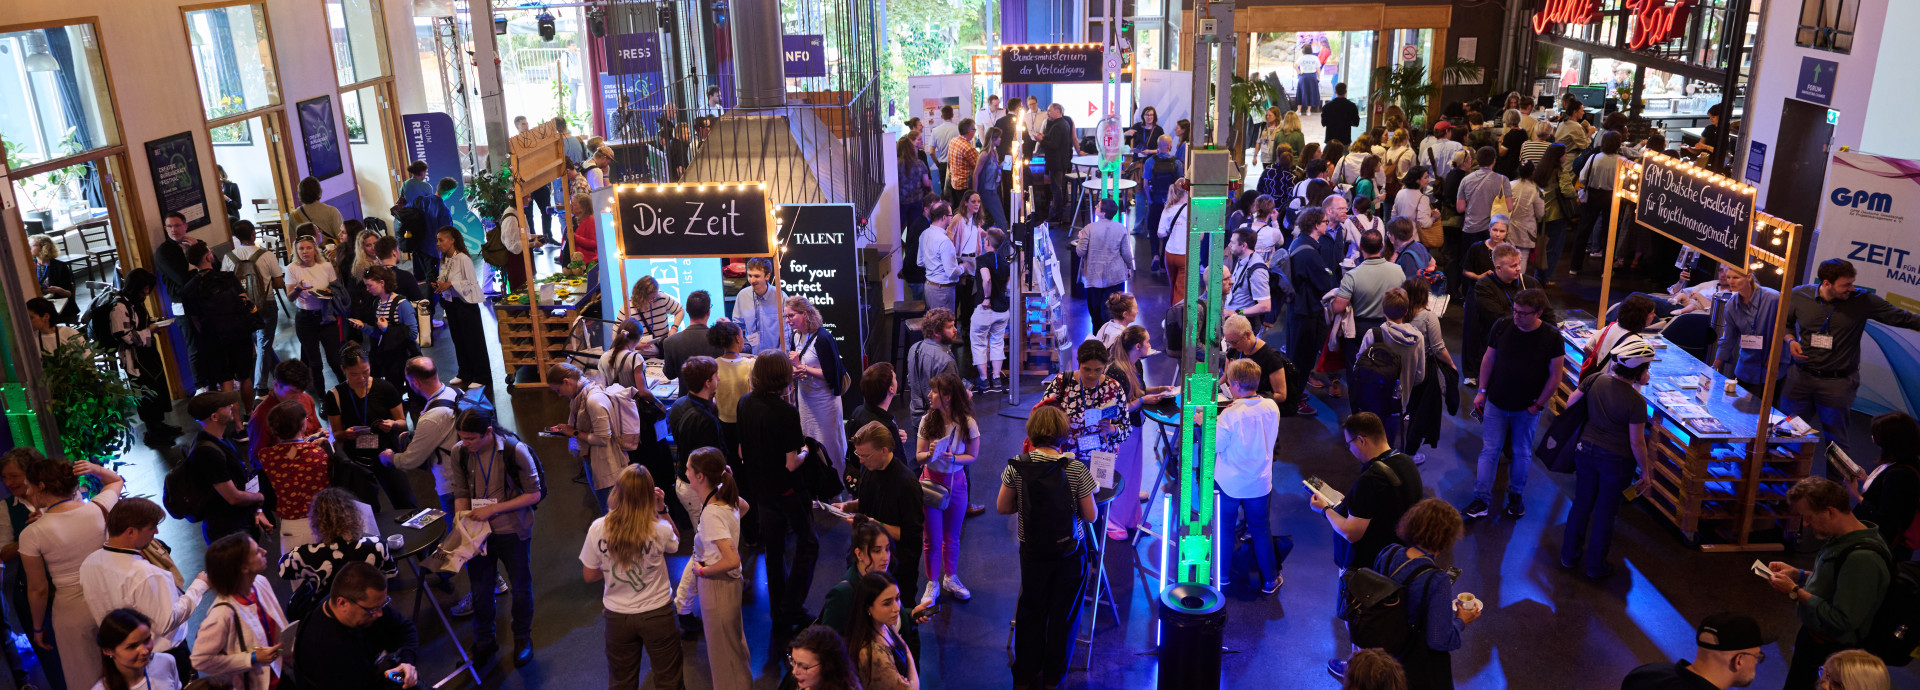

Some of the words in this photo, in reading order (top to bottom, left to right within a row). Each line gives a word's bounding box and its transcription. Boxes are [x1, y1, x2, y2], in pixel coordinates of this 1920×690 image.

[1626, 0, 1684, 50] Bar
[785, 51, 810, 62] NFO
[1010, 48, 1087, 62] Bundesministerium
[1020, 65, 1032, 75] der
[423, 121, 432, 143] FORUM
[1644, 192, 1656, 216] für
[1831, 187, 1893, 213] GPM
[632, 202, 676, 236] Die
[683, 199, 745, 236] Zeit
[793, 232, 845, 245] TALENT
[1847, 240, 1910, 269] ZEIT
[789, 260, 807, 273] for
[682, 270, 693, 284] ist
[809, 269, 837, 282] your
[780, 280, 822, 292] Perfect
[598, 539, 654, 555] CW
